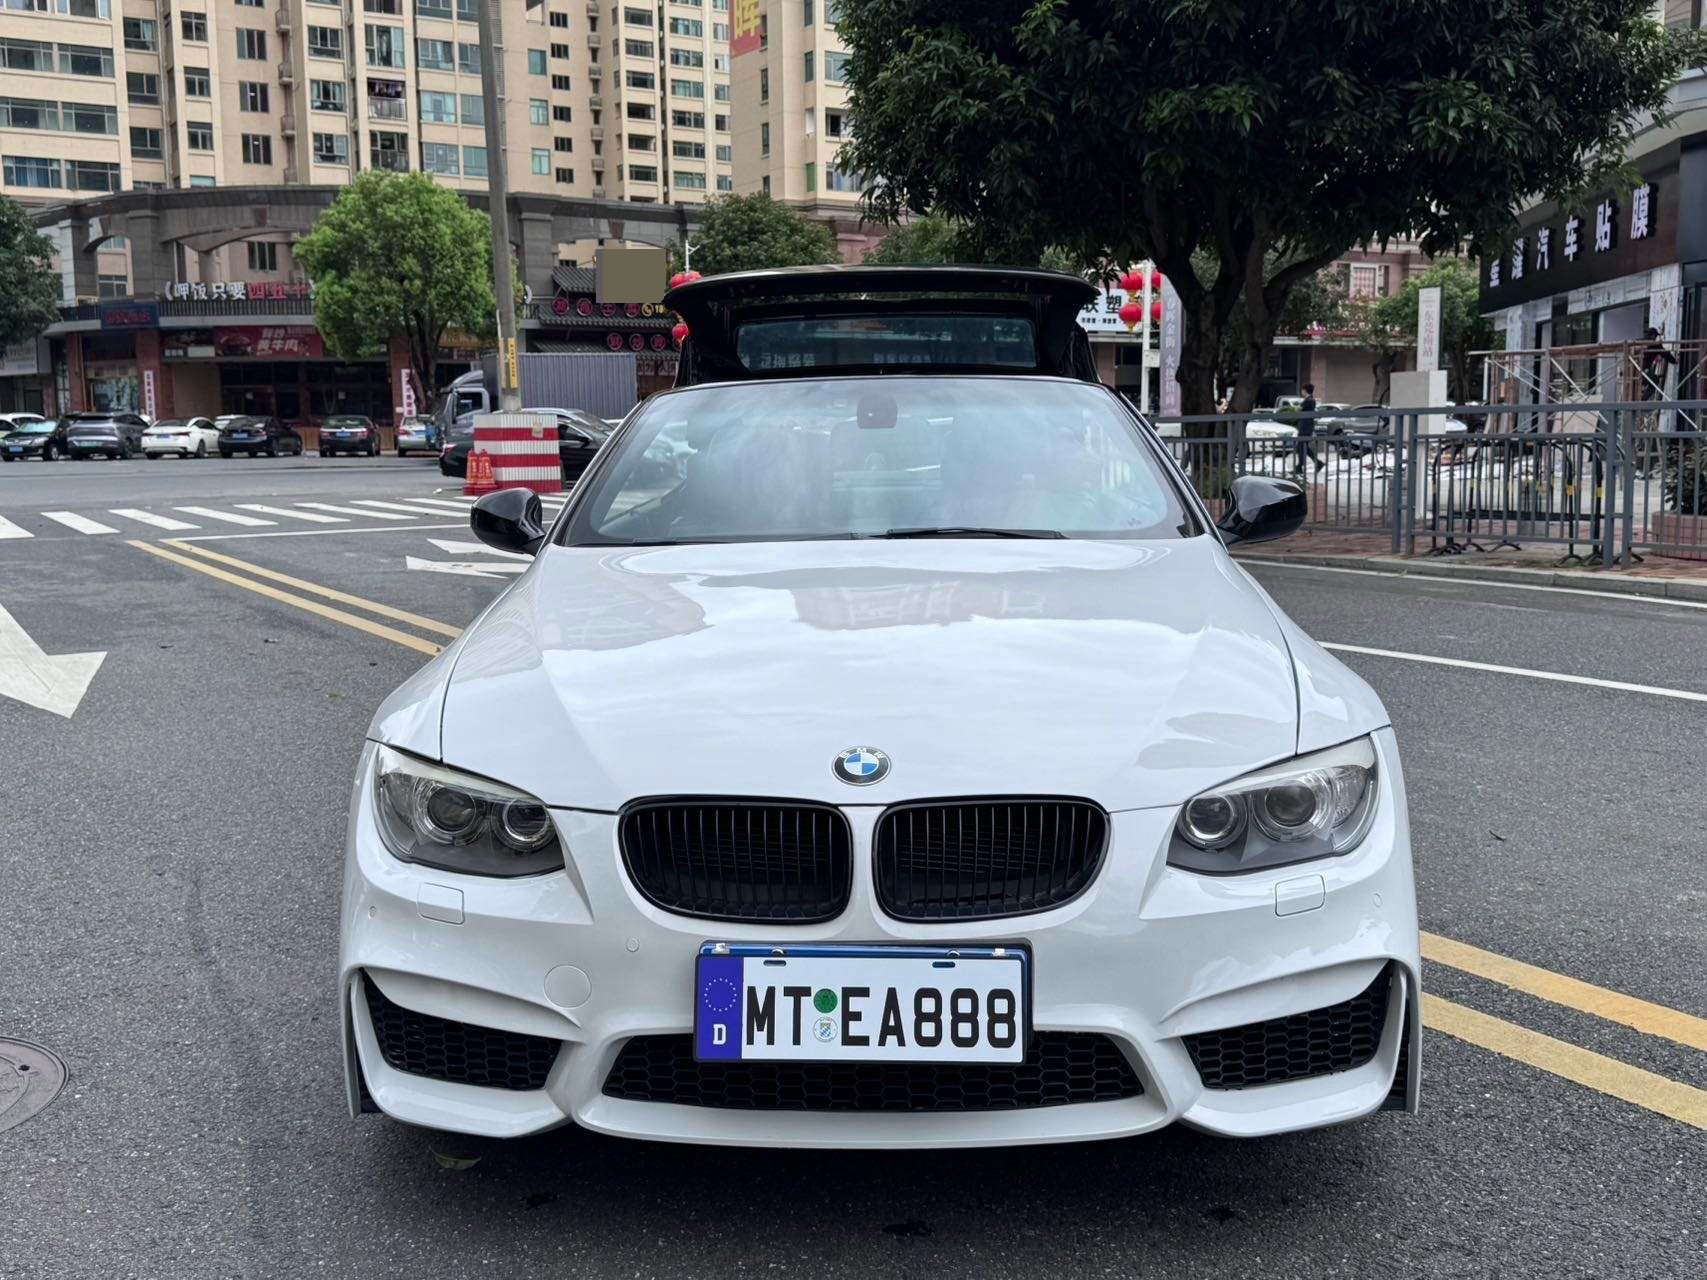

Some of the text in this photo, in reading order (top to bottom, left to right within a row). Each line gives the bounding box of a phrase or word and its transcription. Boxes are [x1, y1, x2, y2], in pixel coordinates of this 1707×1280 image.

[712, 1023, 727, 1046] D
[746, 985, 1017, 1049] MT EA888
